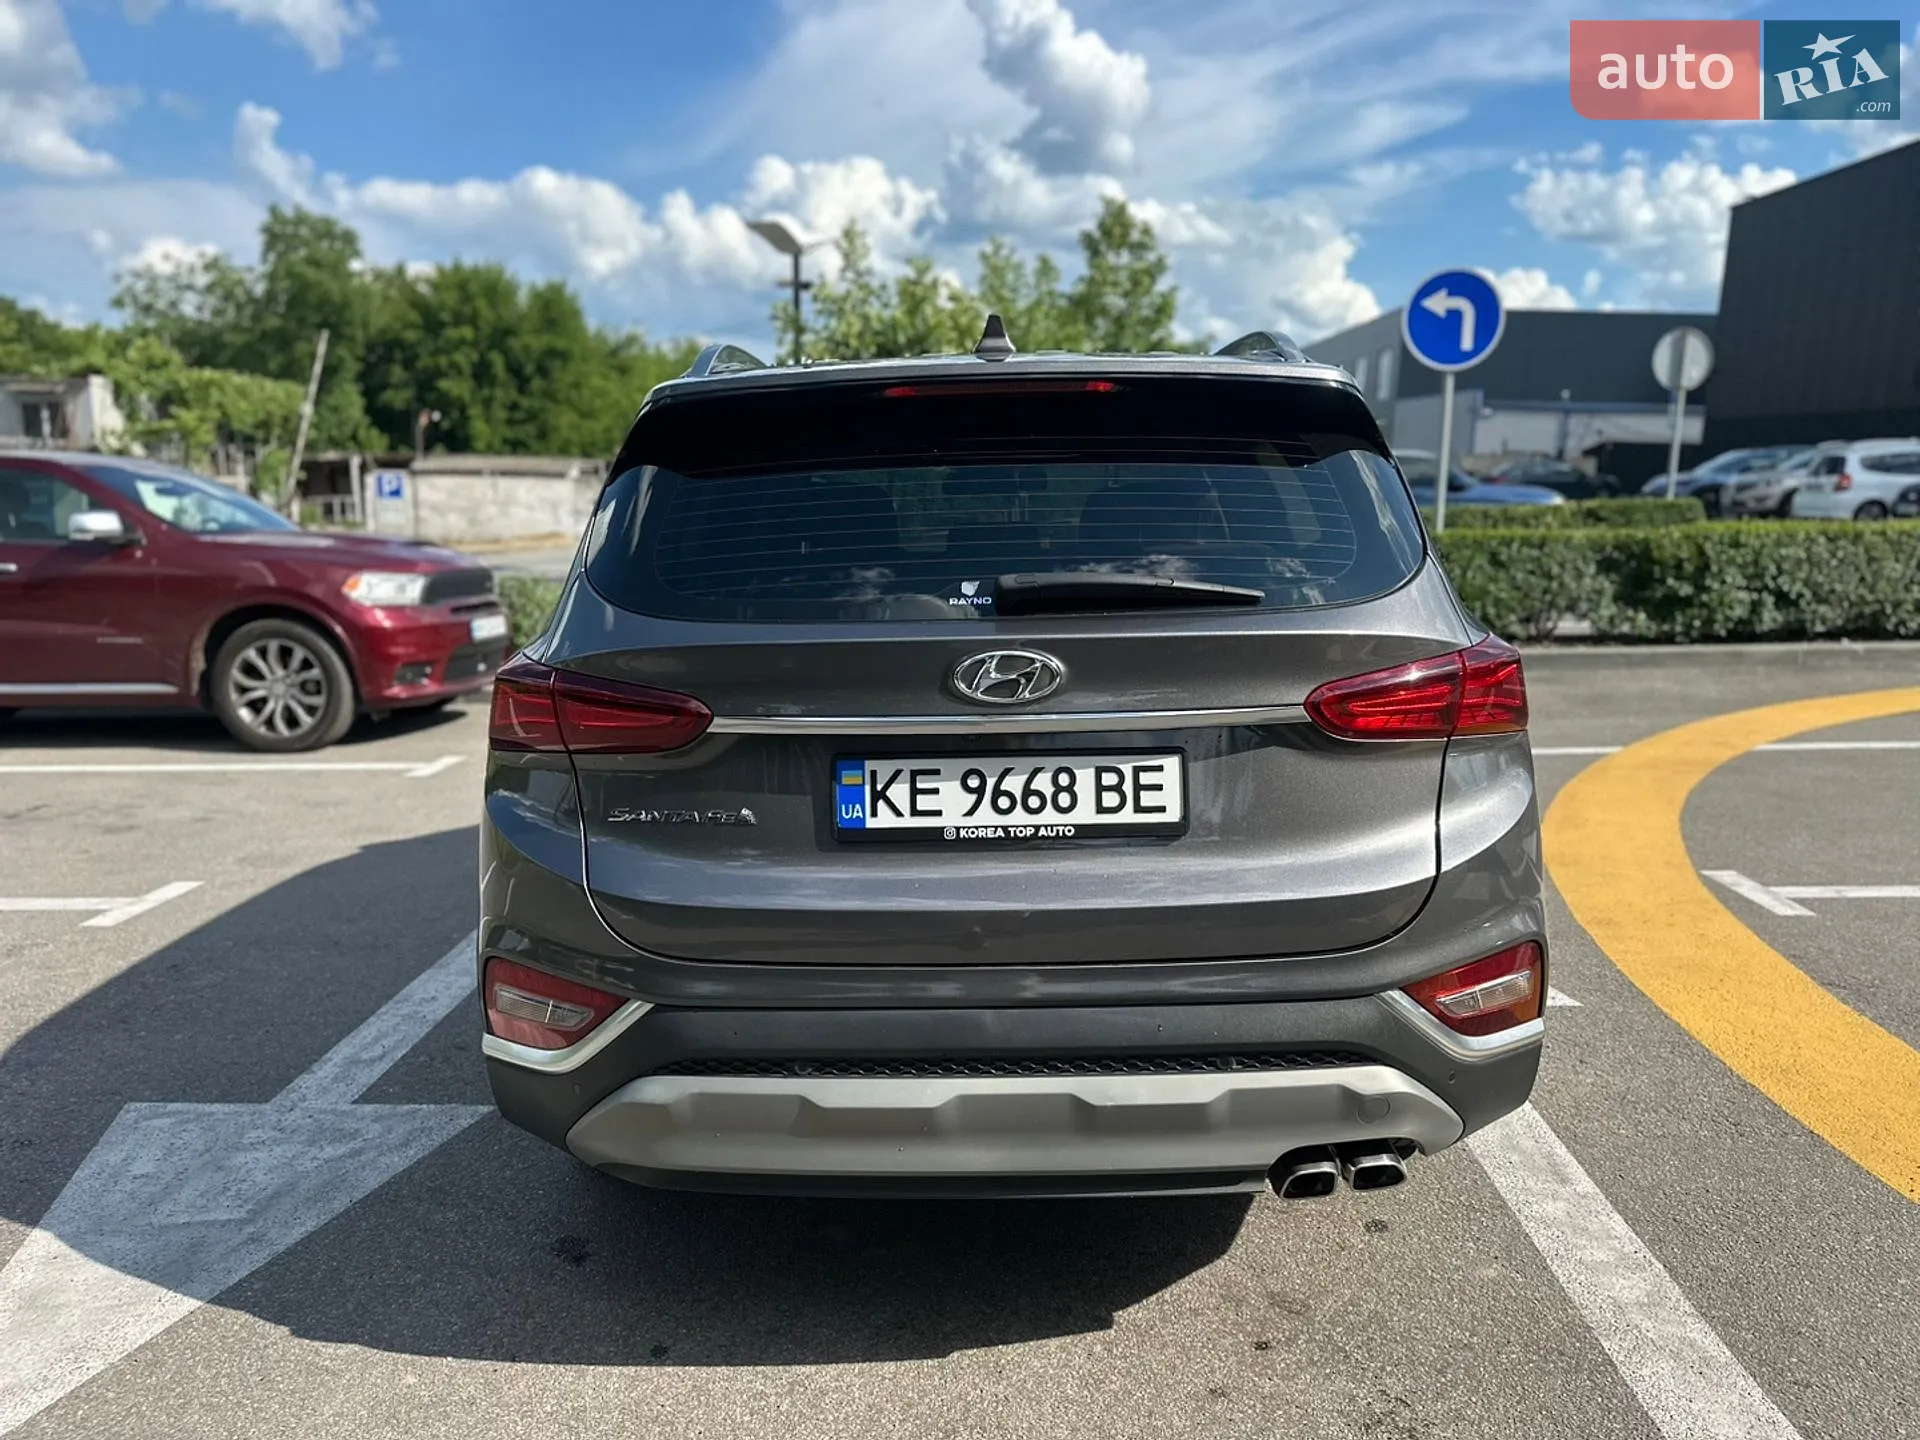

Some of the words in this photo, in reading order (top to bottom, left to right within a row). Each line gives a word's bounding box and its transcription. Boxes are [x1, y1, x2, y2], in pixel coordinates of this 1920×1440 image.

[949, 597, 992, 605] RAYNO
[869, 768, 943, 818] KE
[960, 766, 1078, 817] 9668
[1095, 765, 1167, 815] BE
[842, 804, 863, 819] UA
[959, 826, 1005, 839] KOREA
[1008, 826, 1034, 838] TOP
[1038, 825, 1075, 838] AUTO
